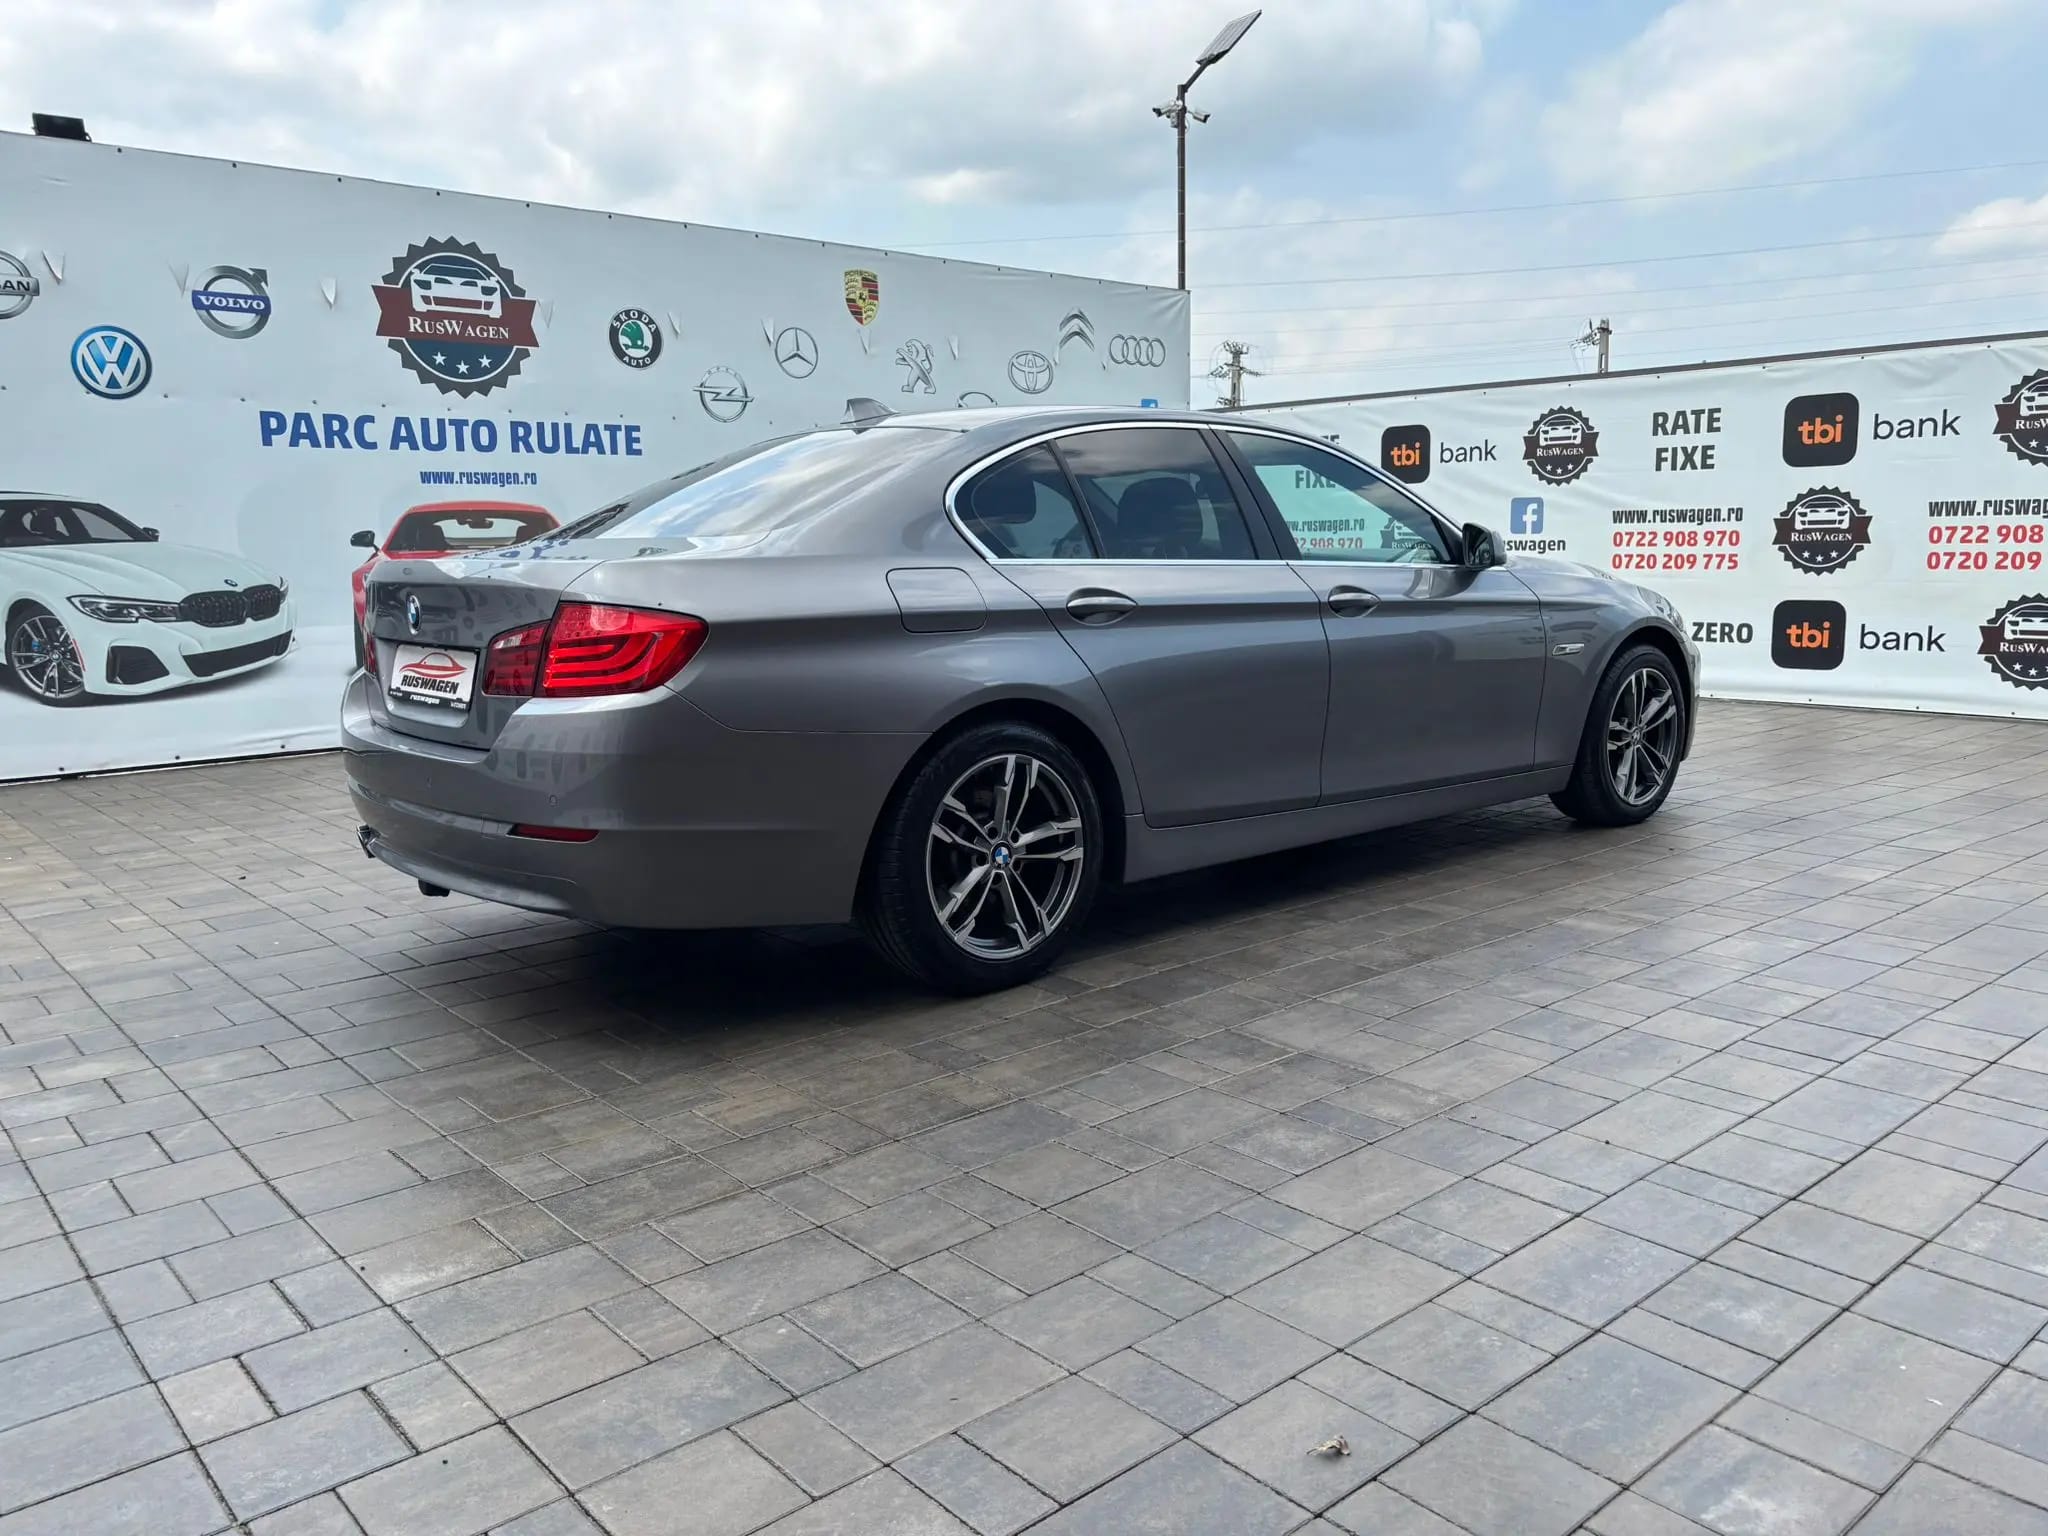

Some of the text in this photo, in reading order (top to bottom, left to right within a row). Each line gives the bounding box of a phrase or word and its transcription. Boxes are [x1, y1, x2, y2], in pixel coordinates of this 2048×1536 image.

[0, 279, 30, 291] AN
[197, 295, 265, 310] VOLVO
[622, 355, 651, 367] AUTO
[1652, 407, 1722, 436] RATE
[1798, 408, 1961, 445] tbi bank
[259, 410, 643, 456] PARC AUTO RULATE
[1390, 439, 1497, 467] tbi bank
[1655, 444, 1716, 472] FIXE
[419, 470, 538, 488] www.ruswagen.ro
[1612, 507, 1743, 526] www.ruswagen.ro
[1613, 530, 1740, 547] 0722 908 970
[1928, 524, 2044, 544] 0722 908
[1504, 540, 1566, 555] swagen
[1612, 553, 1739, 570] 0720 209 775
[1927, 551, 2042, 570] 0720 209
[1691, 621, 1754, 644] ZERO
[1786, 621, 1946, 652] tbi bank
[401, 675, 458, 694] RUSWAGEN
